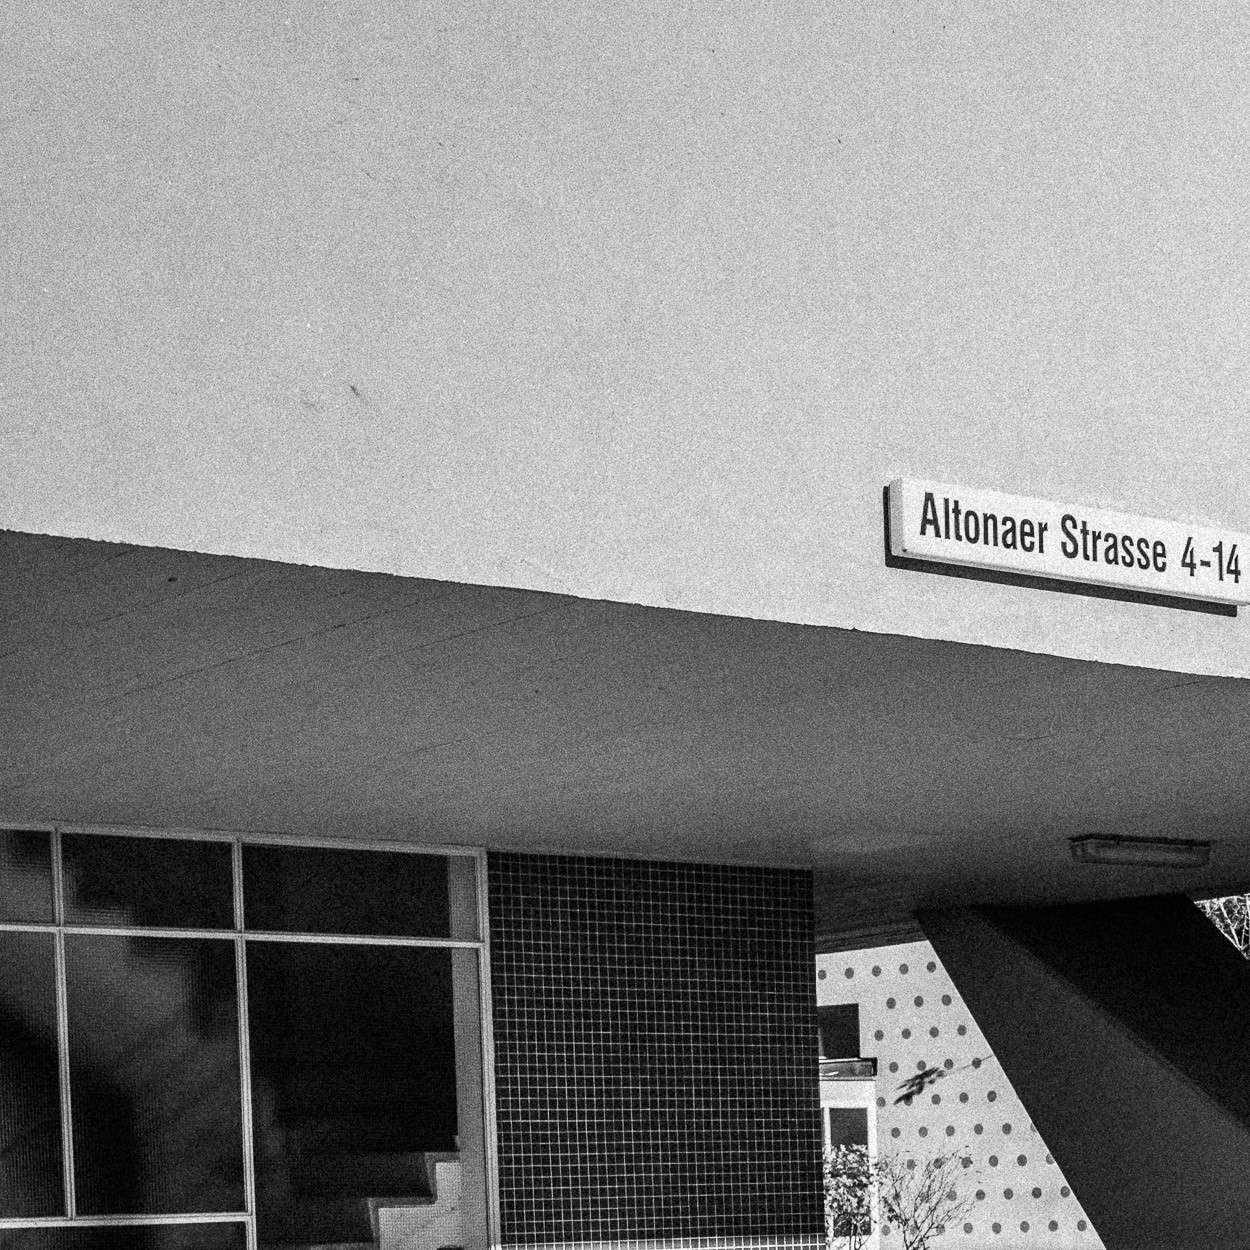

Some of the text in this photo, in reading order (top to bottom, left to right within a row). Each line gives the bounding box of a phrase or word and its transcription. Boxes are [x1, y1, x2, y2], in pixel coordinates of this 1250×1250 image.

[920, 491, 1241, 584] Altonaer Strasse 4-14
